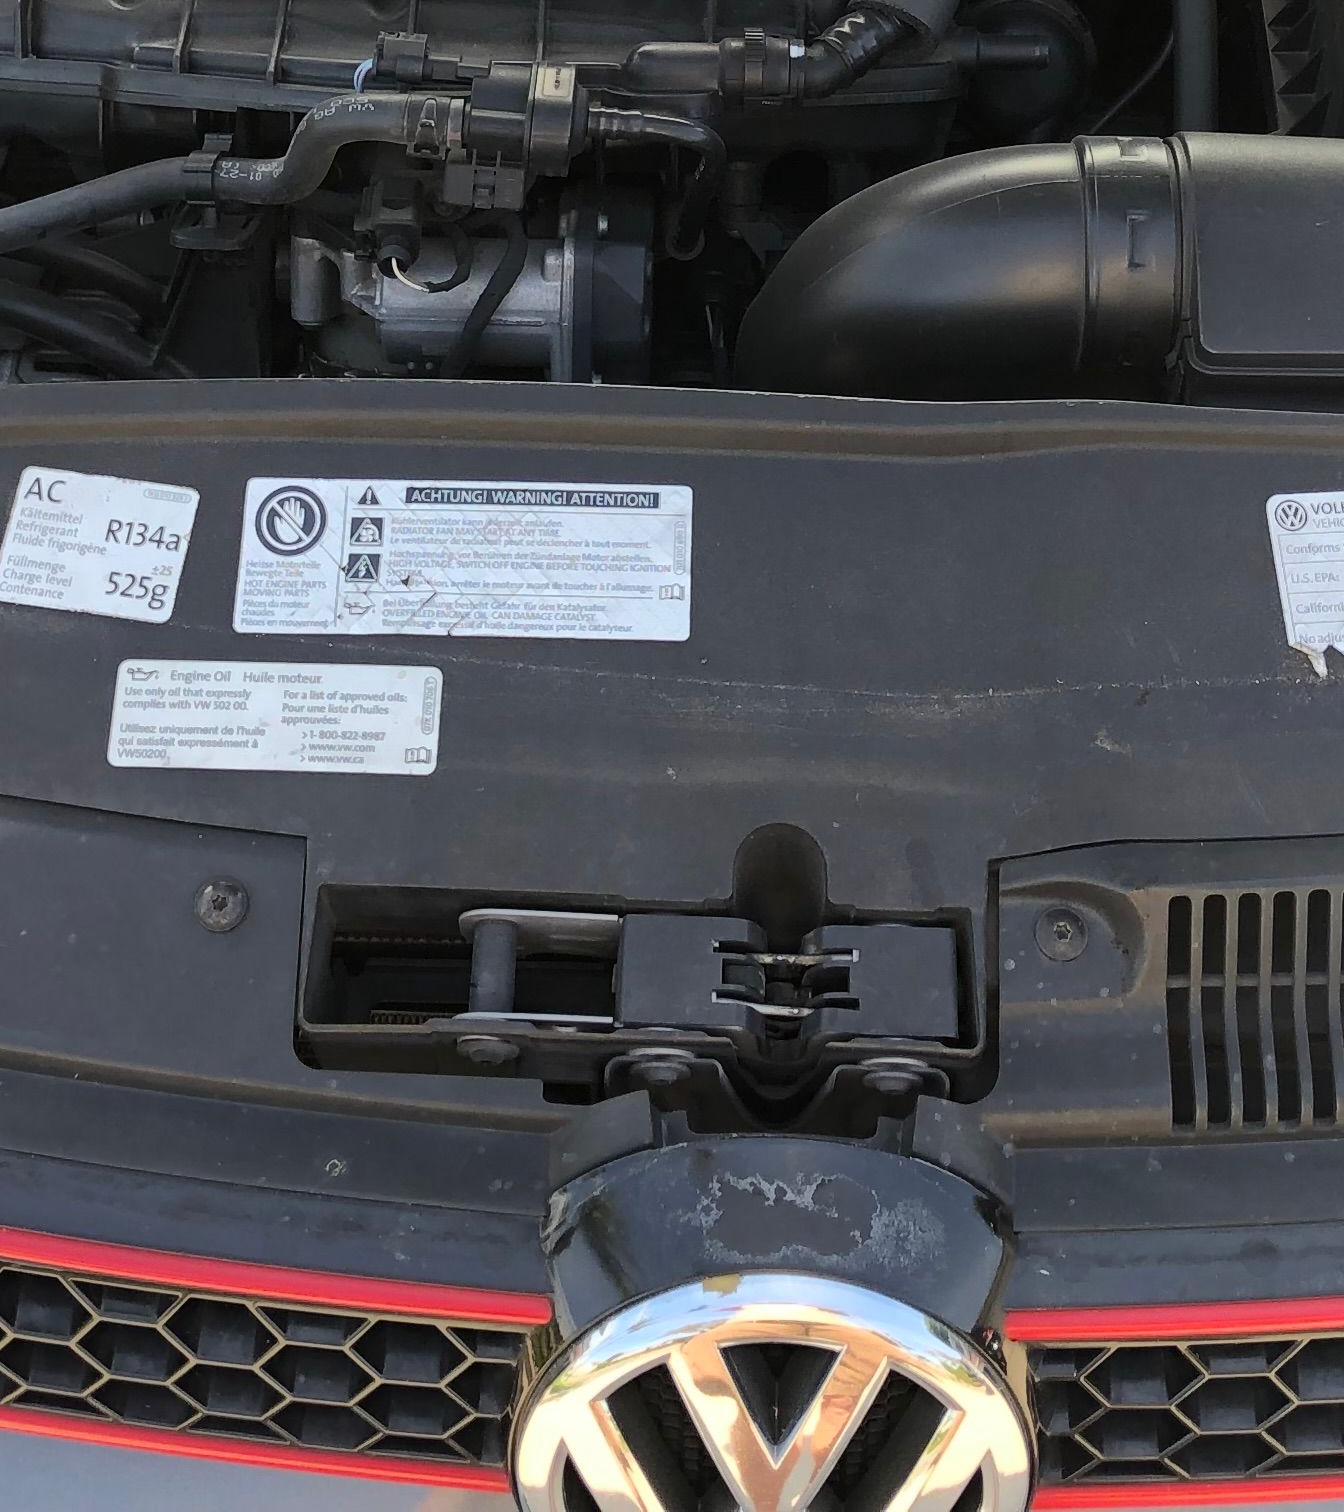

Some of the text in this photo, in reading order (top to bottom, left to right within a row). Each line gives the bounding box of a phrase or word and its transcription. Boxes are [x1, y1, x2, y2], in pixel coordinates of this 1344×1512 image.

[24, 477, 67, 503] AC
[411, 489, 654, 507] ACHTUNG! WARNING! ATTENTION!
[19, 507, 83, 525] Kältemittel
[15, 520, 79, 538] Refrigerant
[391, 527, 434, 535] RADIATOR
[105, 519, 182, 553] R134a
[12, 533, 107, 556] Fluide frigorigène
[1285, 543, 1341, 556] Conforms
[6, 554, 66, 573] Füllmenge
[511, 561, 544, 570] ENGINE
[546, 562, 579, 571] BEFORE
[581, 563, 628, 572] TOUCHING
[630, 564, 671, 573] IGNITION
[152, 565, 173, 577] ±25
[2, 568, 73, 587] Charge level
[105, 571, 169, 610] 525g
[266, 580, 299, 588] ENGINE
[301, 581, 327, 589] PARTS
[0, 582, 64, 600] Contenance
[284, 589, 309, 597] PARTS
[538, 603, 555, 611] den
[473, 611, 486, 619] OIL
[491, 611, 511, 619] CAN
[513, 612, 553, 621] DAMAGE
[508, 622, 554, 632] dangereux
[556, 624, 577, 633] pour
[1298, 634, 1316, 645] No
[170, 669, 322, 684] Engine Oil Huile moteur
[124, 687, 252, 700] Use only oil that expressly
[283, 690, 408, 703] For a list of approved oils:
[122, 699, 249, 711] complies with VW 502 00.
[281, 703, 389, 714] Pour une liste d'huiles
[281, 715, 341, 727] approuvées:
[119, 723, 266, 736] Utilisez uniquement de l'huile
[117, 737, 259, 749] qui satisfait expressément à
[308, 744, 376, 753] www.vw.com
[307, 756, 365, 764] www.vw.ca
